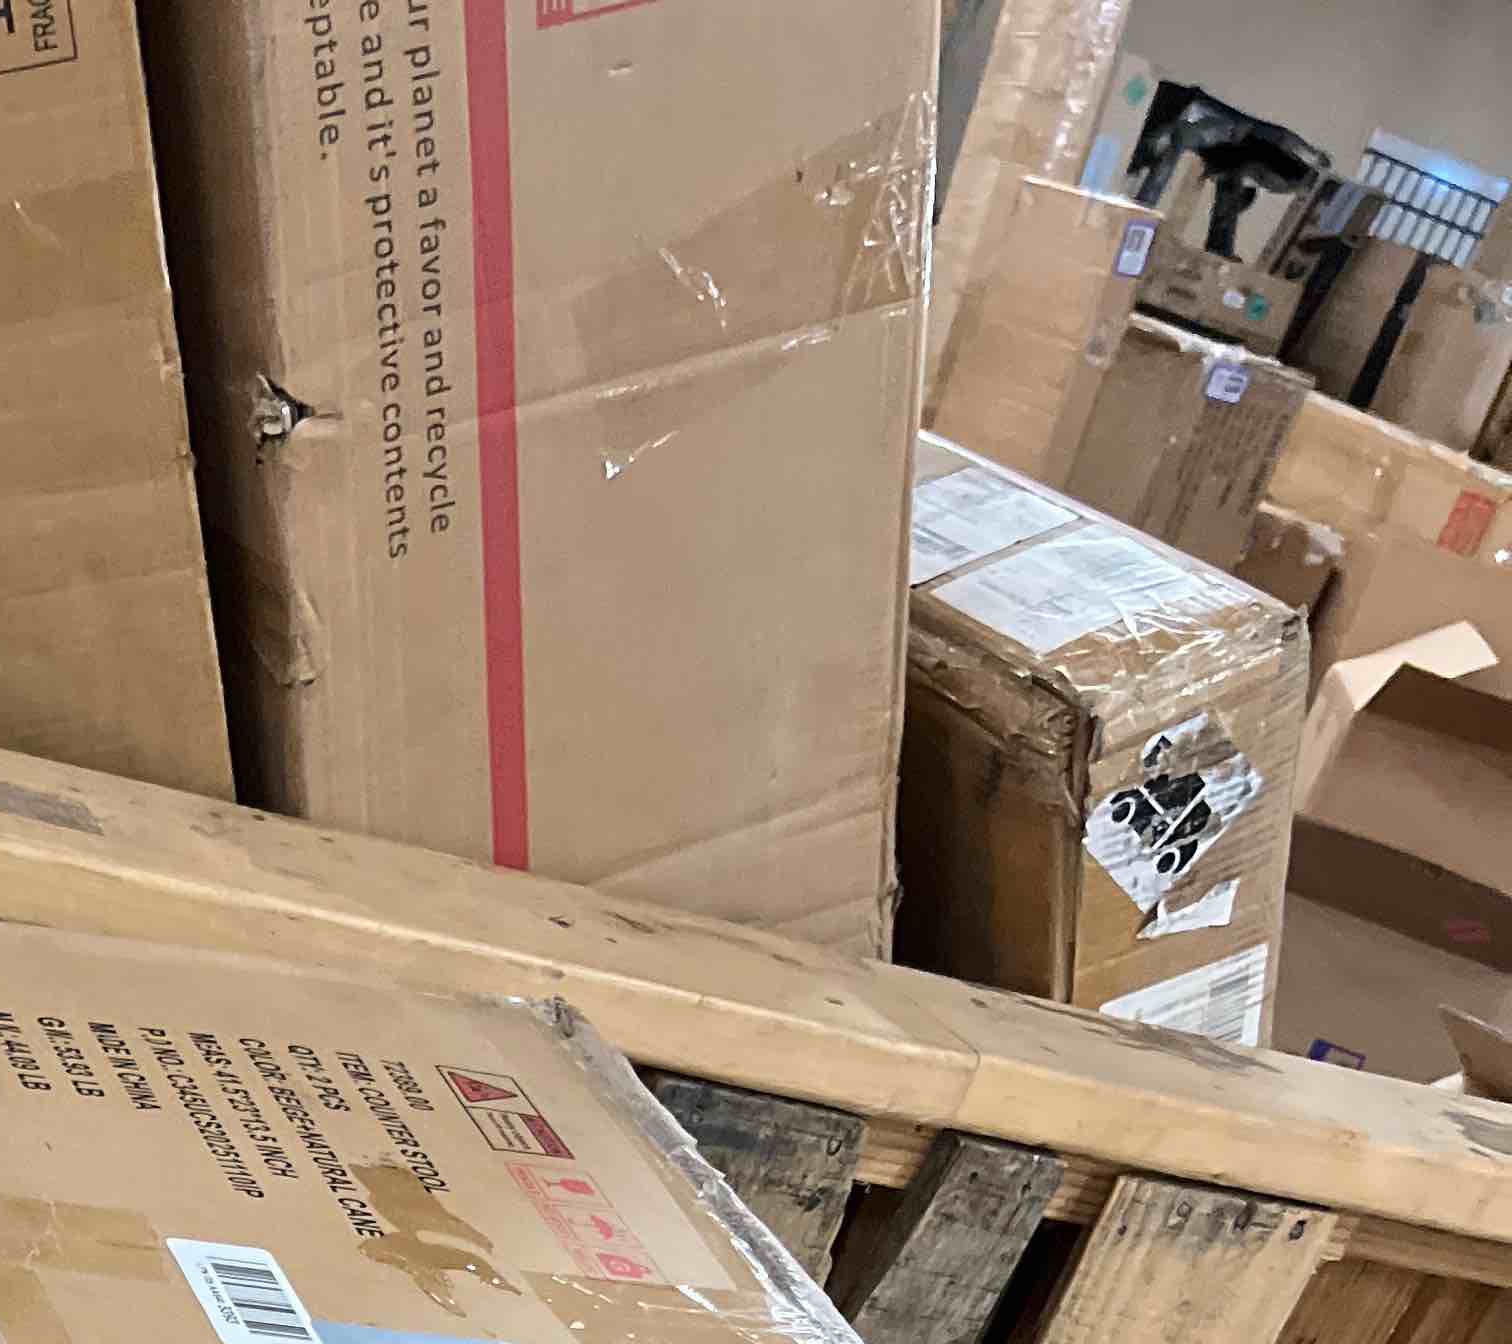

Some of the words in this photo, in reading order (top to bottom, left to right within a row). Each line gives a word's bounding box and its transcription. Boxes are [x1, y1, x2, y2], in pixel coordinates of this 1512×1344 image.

[361, 34, 394, 110] and
[403, 45, 441, 177] planet
[366, 119, 397, 182] it's
[418, 187, 438, 208] a
[419, 218, 447, 317] favor
[364, 193, 405, 393] protective
[423, 328, 452, 396] and
[382, 402, 411, 560] contents
[422, 406, 456, 533] recycle
[0, 1039, 41, 1071] 44.09
[88, 1021, 132, 1056] MADE
[108, 1056, 140, 1071] IN
[288, 1045, 326, 1073] QTY:
[17, 1073, 52, 1091] LB
[72, 1080, 105, 1097] LB
[117, 1072, 162, 1110] CHINA
[306, 1074, 333, 1085] 2
[312, 1085, 352, 1112] PCS
[239, 1038, 292, 1084] COLOR:
[337, 1197, 385, 1238] CANE
[336, 1051, 377, 1086] ITEM:
[358, 1086, 421, 1148] COUNTER
[400, 1148, 451, 1195] STOOL
[255, 1144, 300, 1179] INCH
